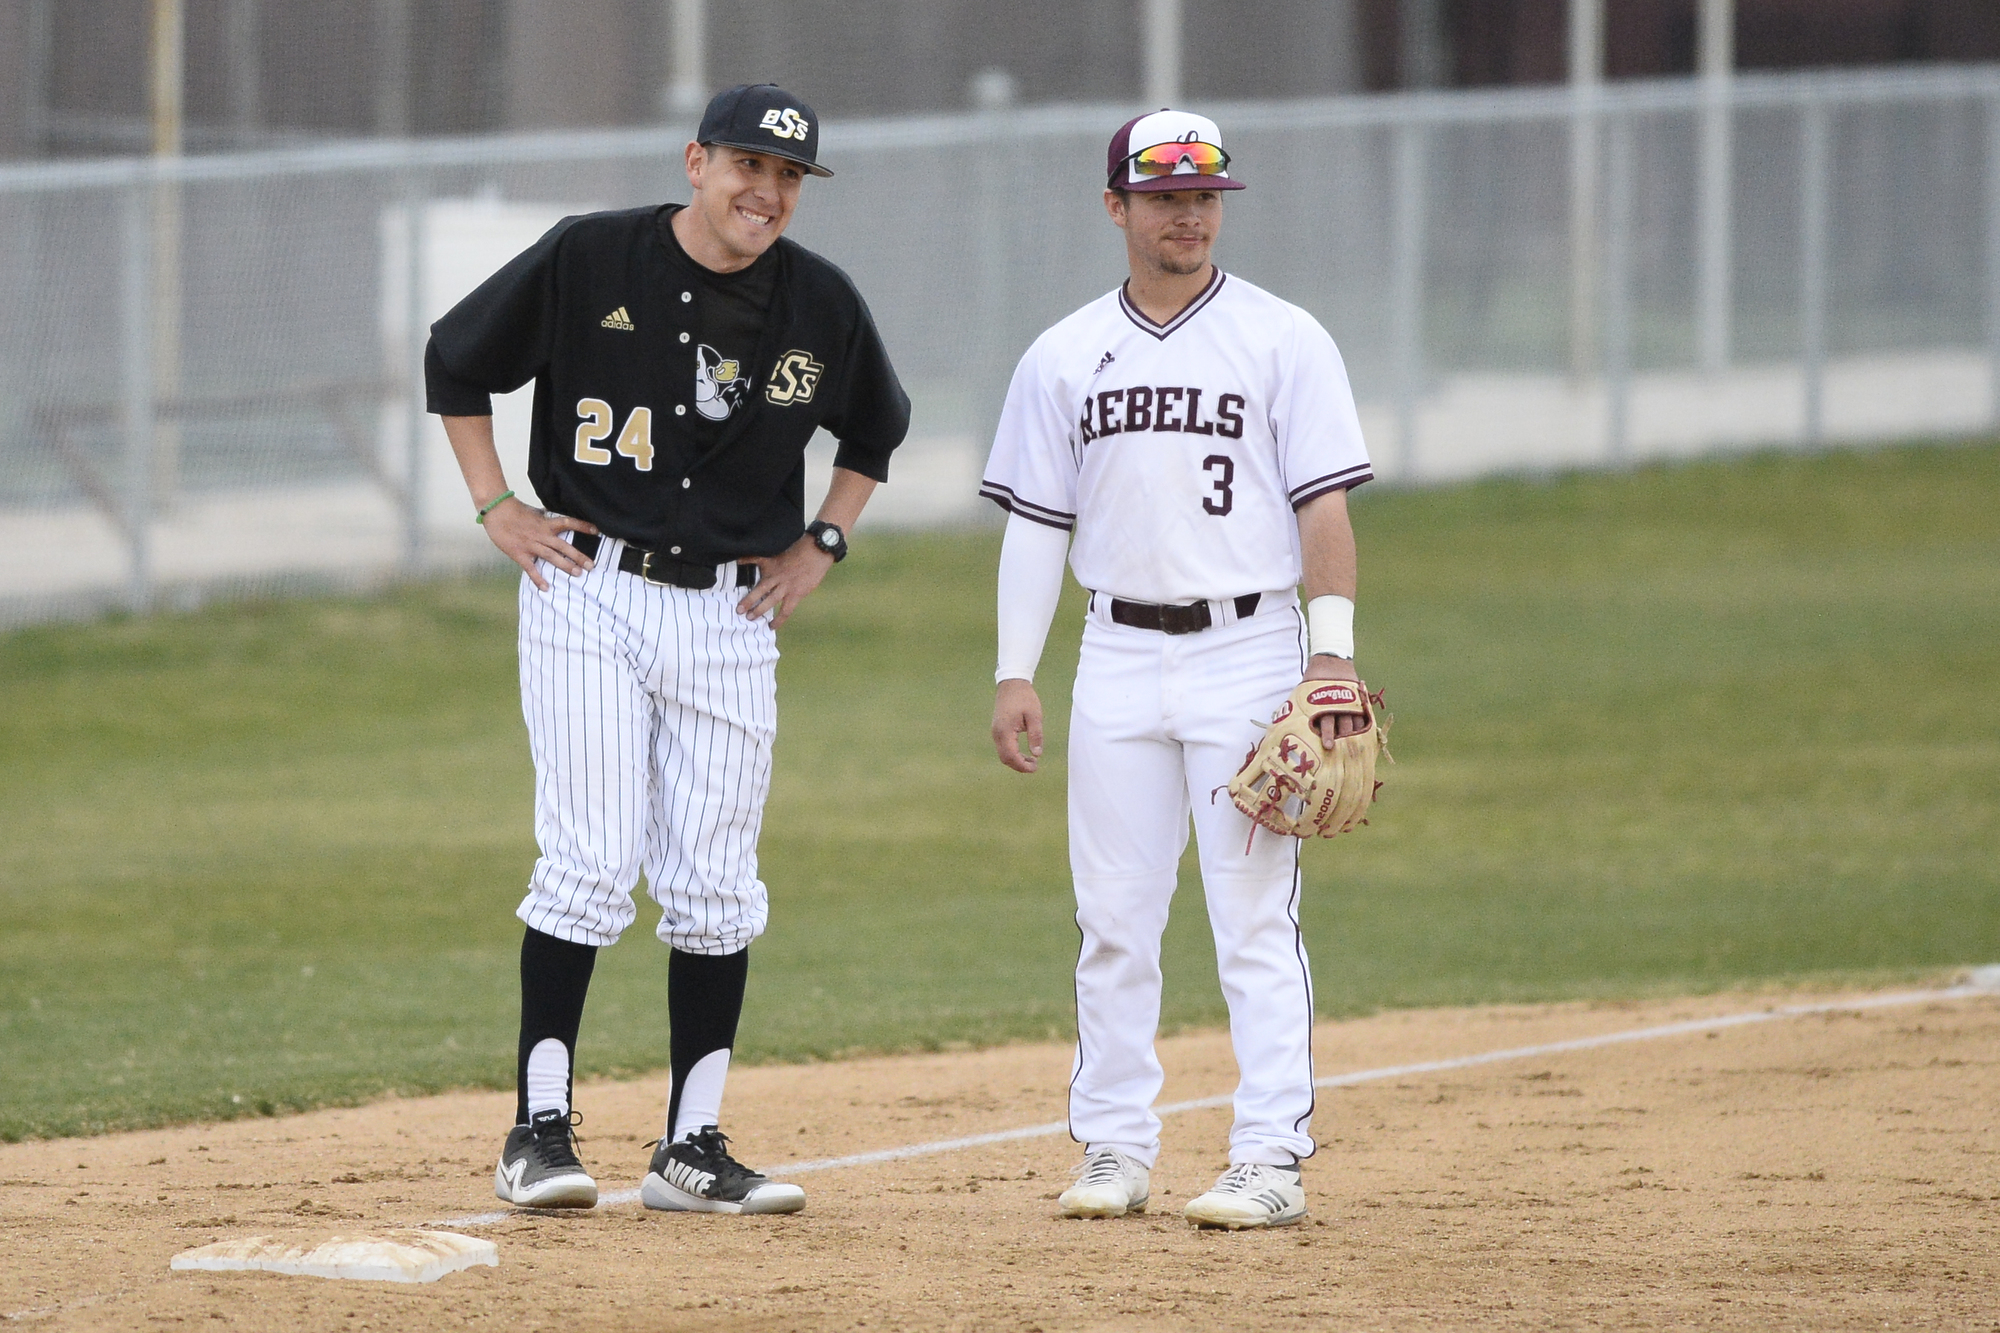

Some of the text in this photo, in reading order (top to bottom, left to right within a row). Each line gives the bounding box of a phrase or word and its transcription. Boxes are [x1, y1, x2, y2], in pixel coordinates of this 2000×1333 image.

[601, 319, 634, 331] adidas
[574, 398, 654, 471] 24
[1080, 386, 1245, 445] REBELS
[1202, 454, 1234, 516] 3
[1311, 687, 1354, 702] Wilson
[1313, 788, 1335, 826] A2000
[664, 1157, 716, 1198] NIKE
